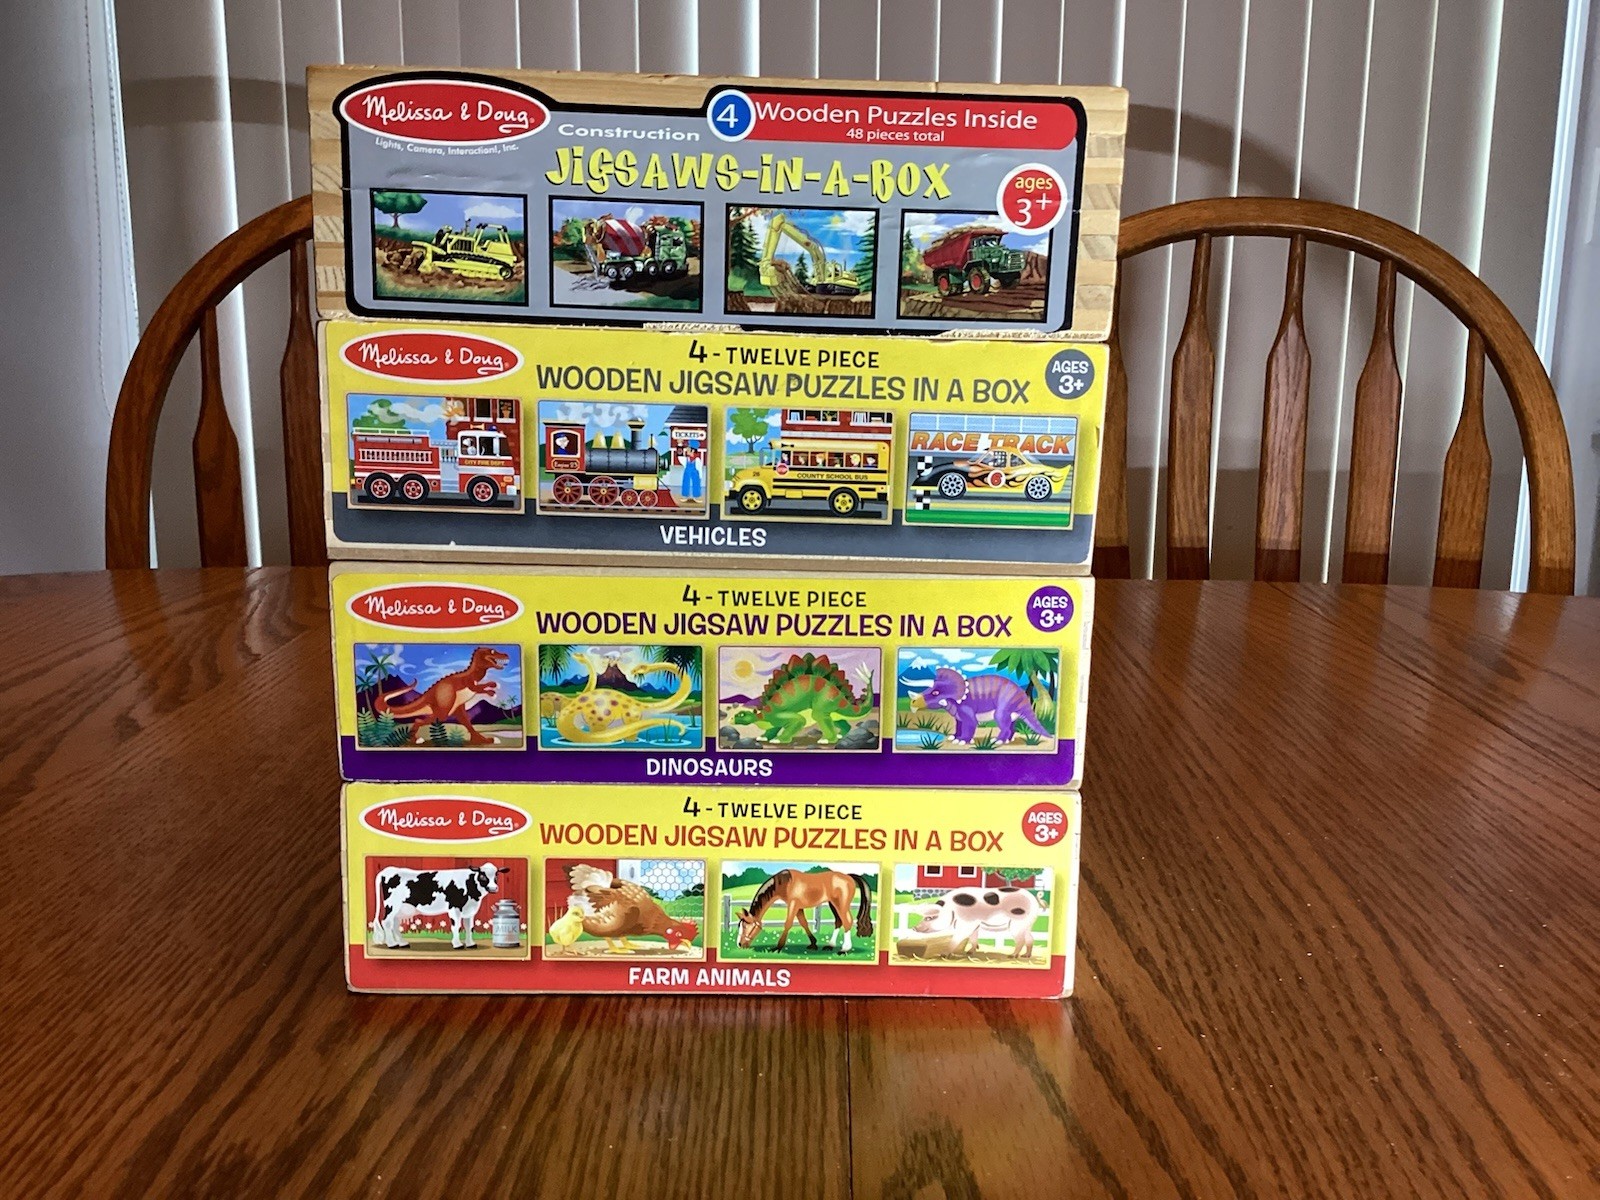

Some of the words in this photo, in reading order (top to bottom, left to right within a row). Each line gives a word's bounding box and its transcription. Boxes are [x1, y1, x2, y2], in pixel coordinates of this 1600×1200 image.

[362, 95, 452, 125] Melissa
[460, 102, 471, 121] &
[477, 100, 529, 133] Doug
[717, 104, 738, 128] 4
[756, 102, 860, 125] Wooden
[868, 106, 957, 127] Puzzles
[964, 109, 1037, 130] Inside
[558, 123, 700, 142] Construction
[846, 128, 863, 140] 48
[867, 129, 910, 143] pieces
[913, 130, 944, 142] total
[375, 137, 404, 152] Lights,
[407, 143, 445, 156] Camera,
[1015, 175, 1053, 192] ages
[1015, 193, 1052, 226] 3+
[359, 342, 438, 368] Melissa
[445, 349, 454, 364] &
[460, 347, 503, 375] Doug
[818, 350, 879, 369] PIECE
[1052, 360, 1088, 375] AGES
[537, 365, 661, 393] WOODEN
[669, 370, 778, 396] JIGSAW
[786, 374, 905, 400] PUZZLES
[914, 378, 939, 401] IN
[947, 378, 964, 402] A
[973, 379, 1030, 404] BOX
[1058, 376, 1084, 394] 3+
[911, 432, 981, 451] RACE
[988, 434, 1074, 454] TRACK
[660, 526, 767, 548] VEHICLES
[365, 595, 441, 620] Melissa
[448, 600, 456, 614] &
[462, 598, 503, 622] Doug
[807, 592, 866, 607] PIECE
[1032, 595, 1068, 609] AGES
[536, 611, 656, 634] WOODEN
[664, 612, 769, 636] JIGSAW
[776, 613, 892, 636] PUZZLES
[900, 615, 924, 637] IN
[932, 615, 948, 637] A
[958, 615, 1013, 638] BOX
[1039, 609, 1064, 627] 3+
[646, 758, 773, 777] DINOSAURS
[378, 808, 451, 831] Melissa
[458, 812, 466, 826] &
[472, 810, 512, 834] Doug
[805, 804, 862, 820] PIECE
[1028, 812, 1062, 824] AGES
[539, 823, 656, 846] WOODEN
[664, 826, 767, 848] JIGSAW
[774, 827, 886, 851] PUZZLES
[894, 830, 917, 851] IN
[926, 831, 942, 851] A
[950, 831, 1004, 852] BOX
[1034, 825, 1058, 842] 3+
[629, 967, 689, 986] FARM
[696, 968, 791, 987] ANIMALS
